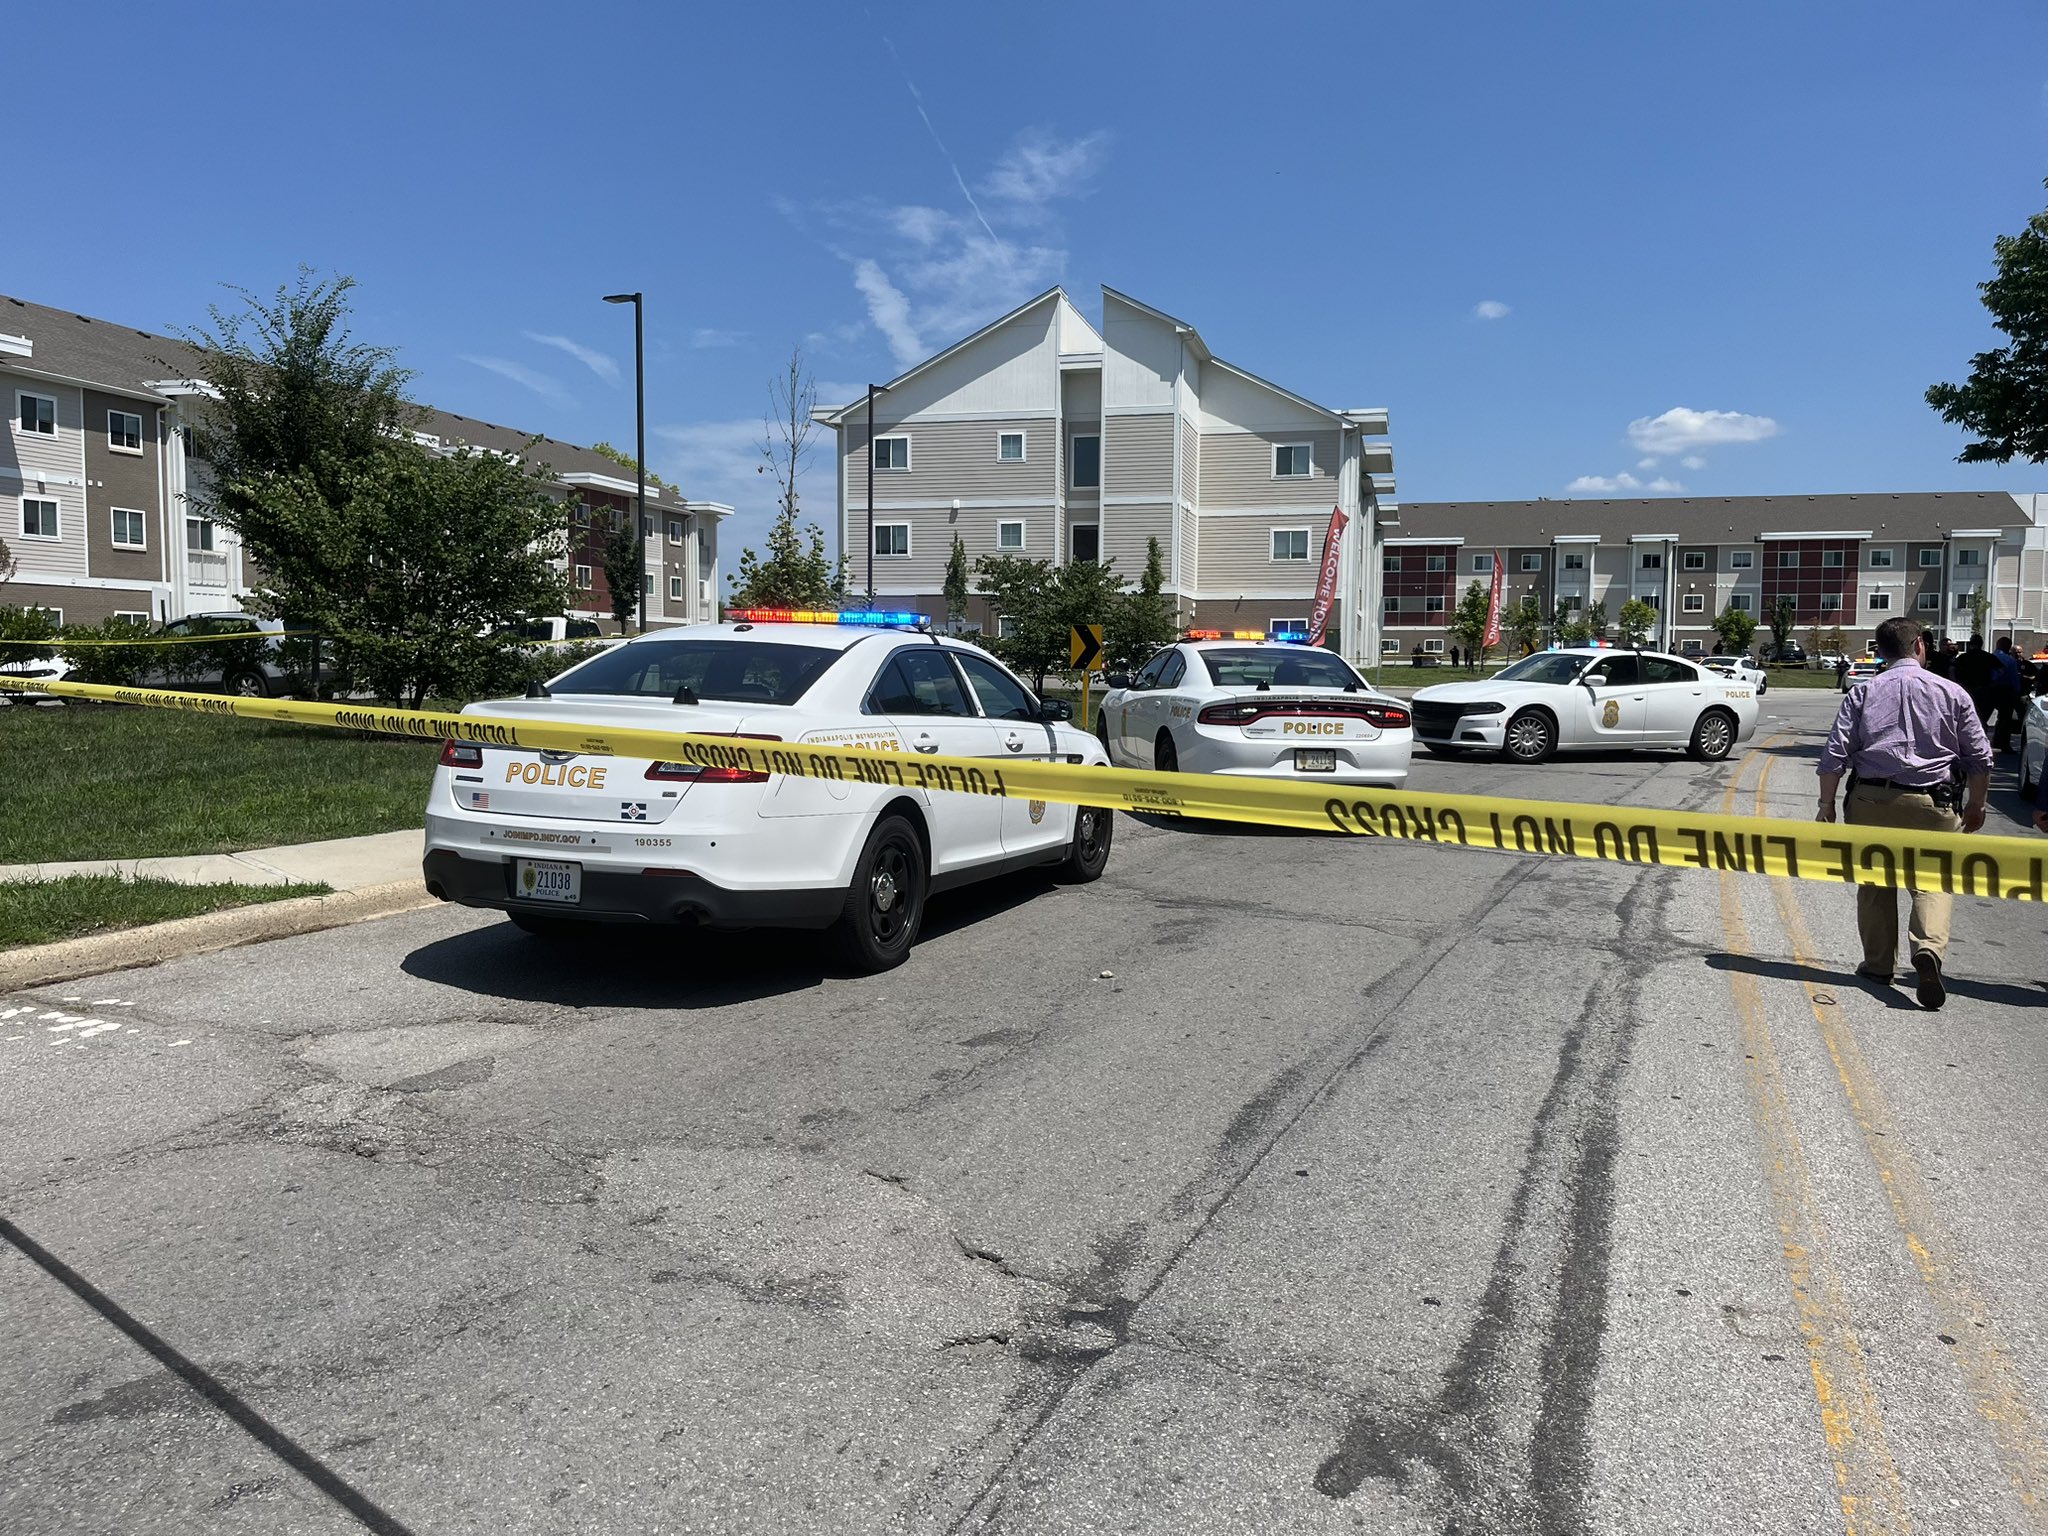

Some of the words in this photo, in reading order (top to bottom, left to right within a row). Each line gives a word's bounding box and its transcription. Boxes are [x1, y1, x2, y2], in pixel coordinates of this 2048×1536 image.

[1319, 528, 1341, 598] WELCOME
[807, 734, 853, 744] INDIANAPOLIS
[855, 731, 896, 740] METROPOLITAN
[1283, 722, 1345, 735] POLICE
[506, 762, 607, 789] POLICE
[846, 757, 903, 786] LINE
[1325, 799, 1466, 845] CROSS
[1490, 812, 1577, 855] NOT
[503, 830, 581, 844] JOINIMPD.INDY.GOV
[634, 838, 672, 847] 190355
[1594, 821, 1660, 863] DO
[534, 862, 563, 870] INDIANA
[1677, 828, 1799, 877] LINE
[537, 870, 571, 890] 21038
[1821, 840, 2042, 903] POLICE
